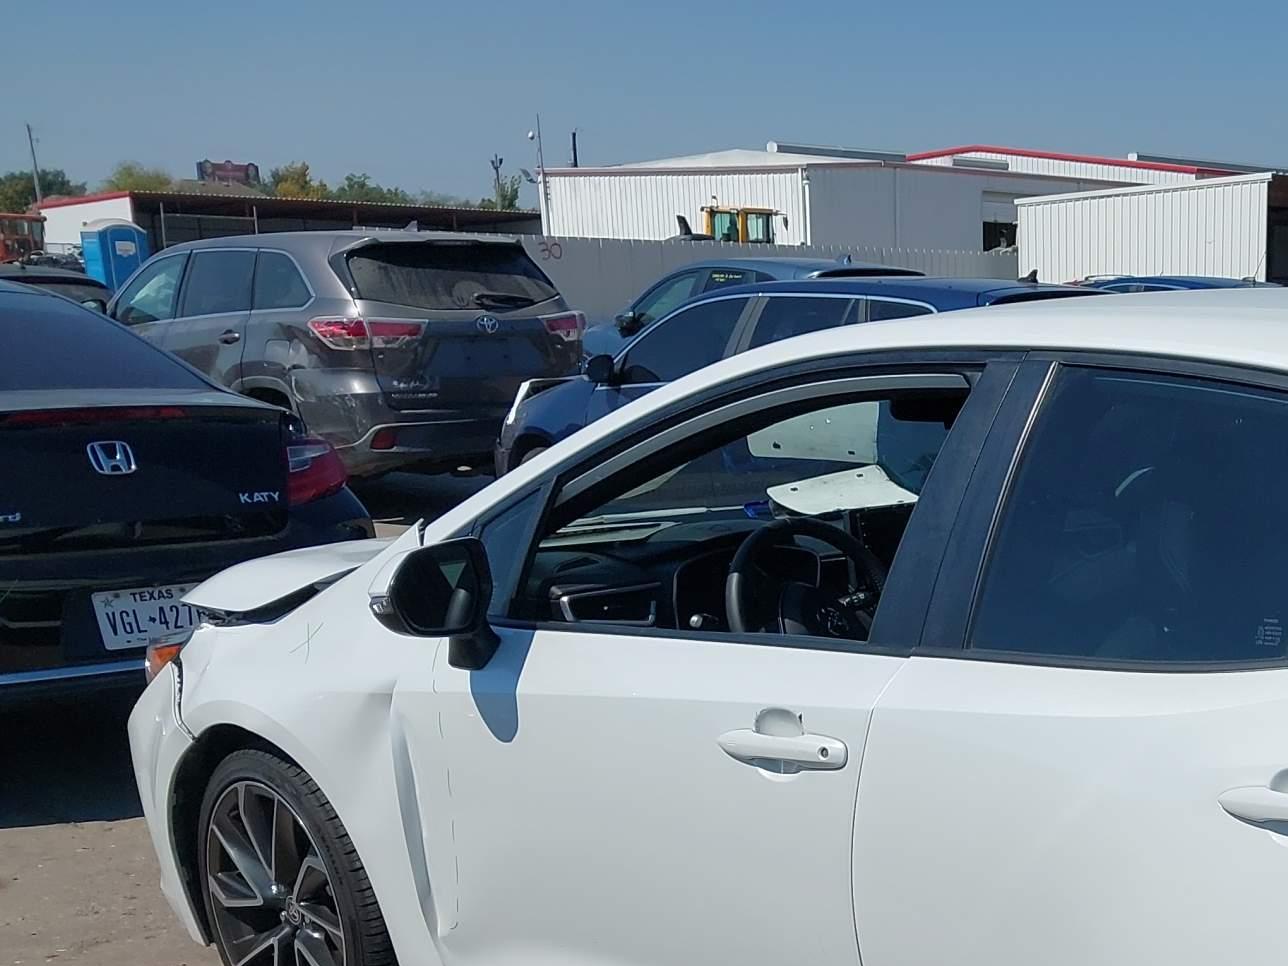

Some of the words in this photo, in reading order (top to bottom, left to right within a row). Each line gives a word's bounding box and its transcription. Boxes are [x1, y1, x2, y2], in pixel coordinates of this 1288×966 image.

[538, 241, 563, 260] 30
[239, 491, 279, 504] KATY
[130, 588, 174, 603] TEXAS
